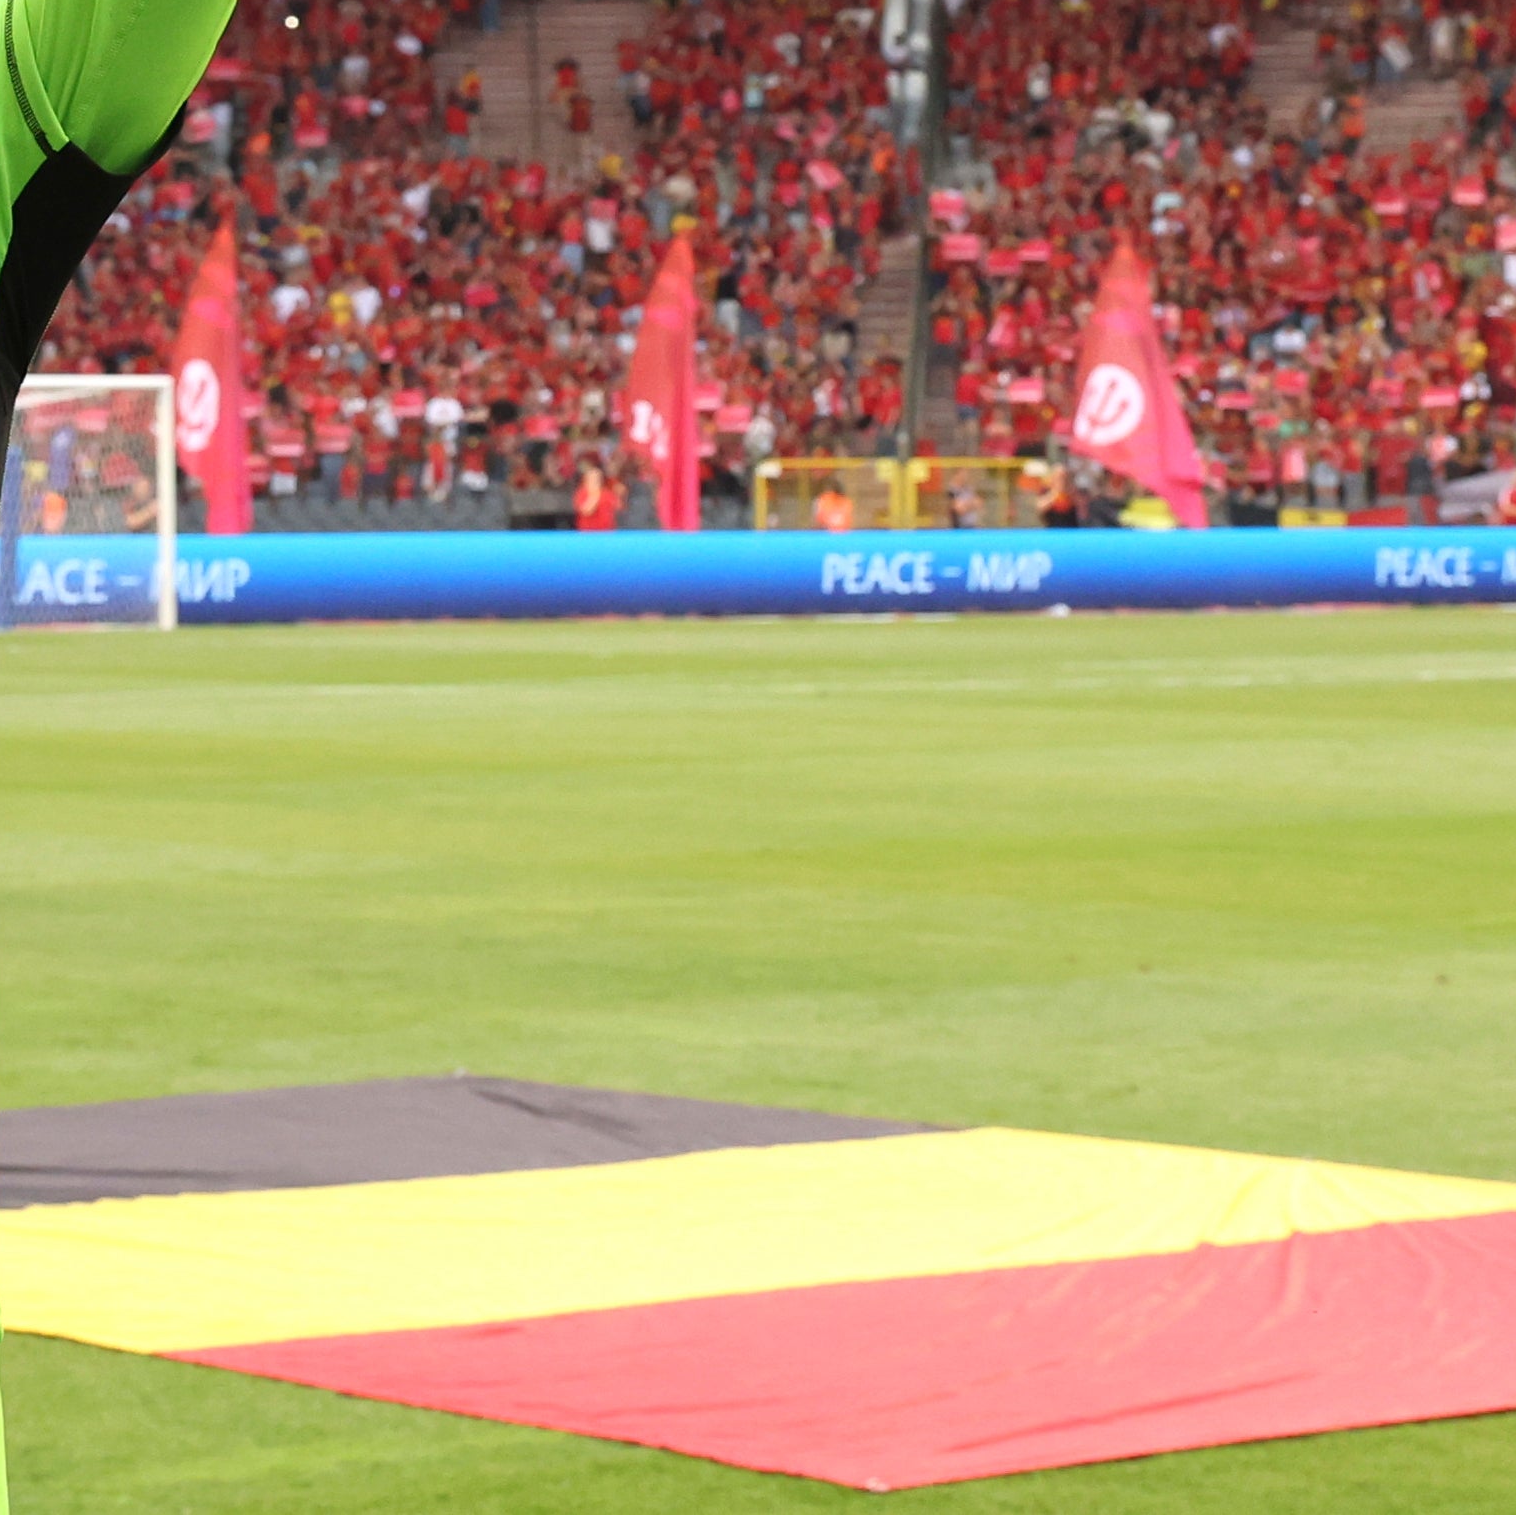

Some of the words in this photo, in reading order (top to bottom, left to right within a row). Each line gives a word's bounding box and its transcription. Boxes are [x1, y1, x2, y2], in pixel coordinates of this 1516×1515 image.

[11, 557, 109, 605] ACE
[821, 550, 934, 595] PEACE
[1374, 546, 1475, 588] PEACE
